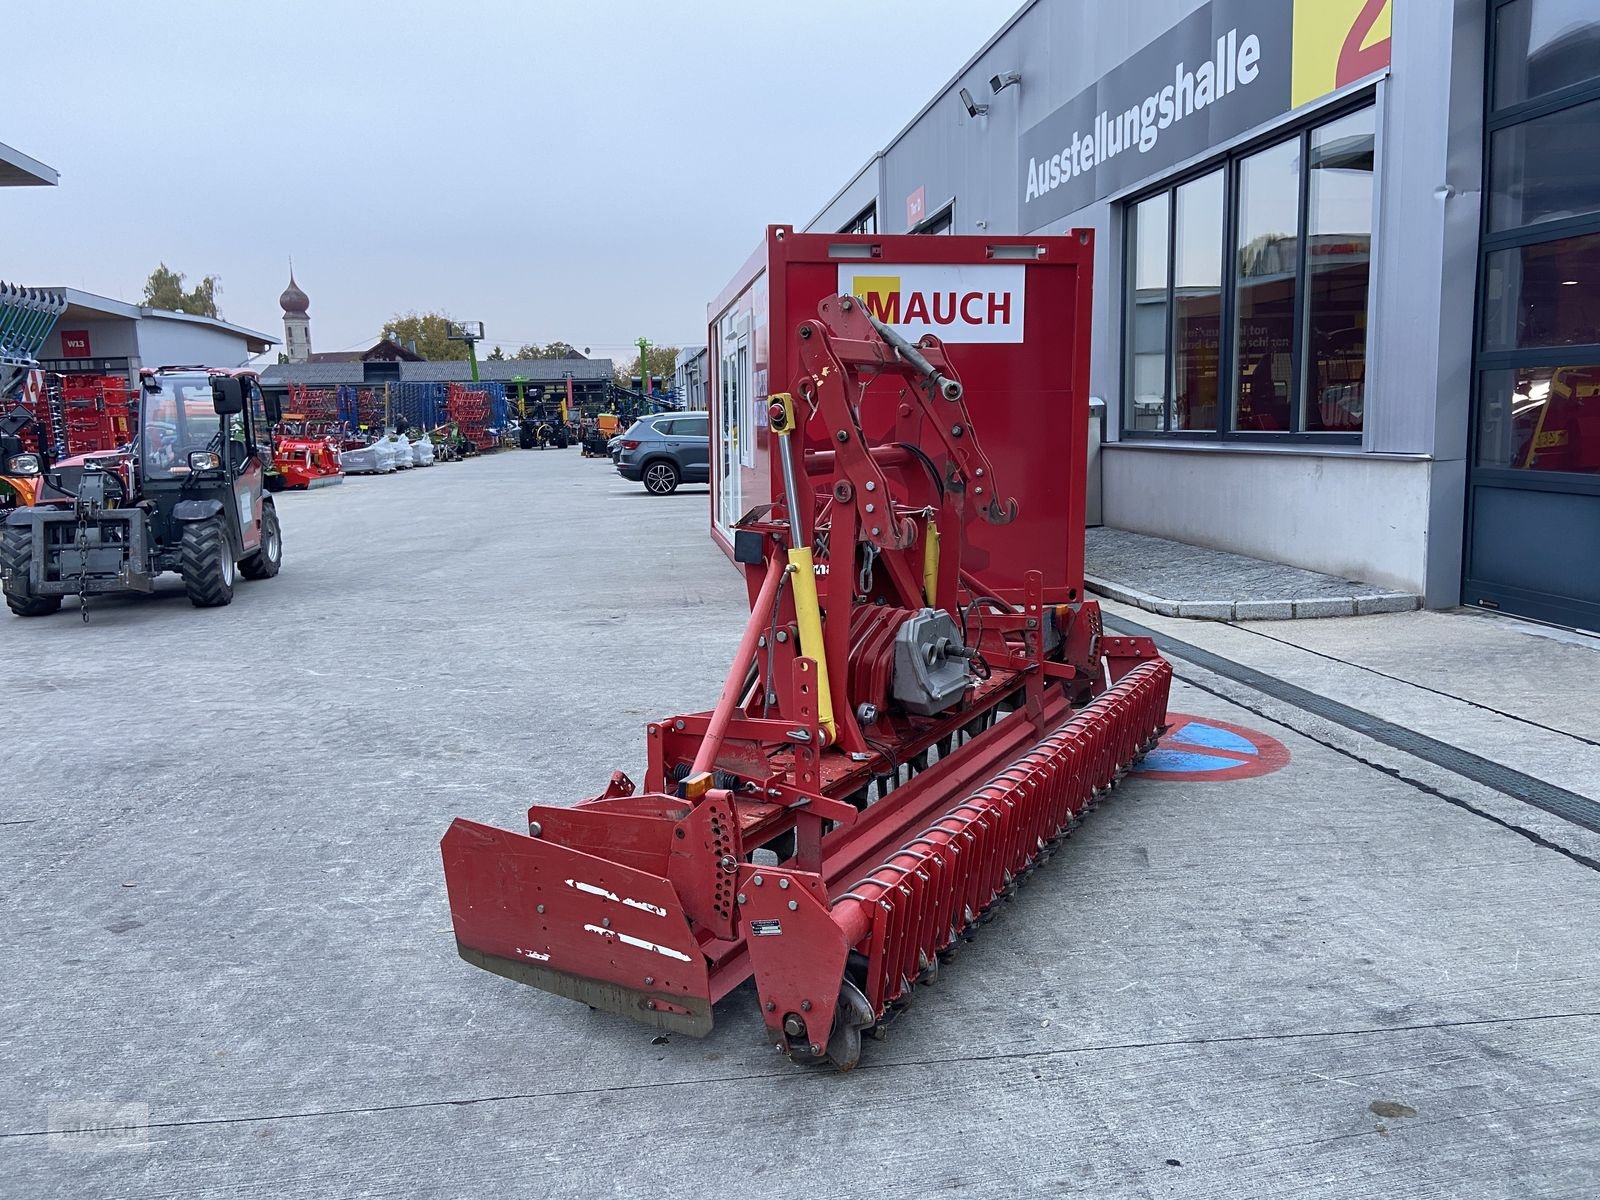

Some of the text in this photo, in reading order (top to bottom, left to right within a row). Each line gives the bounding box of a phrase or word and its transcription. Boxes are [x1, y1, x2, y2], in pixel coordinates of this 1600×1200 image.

[1025, 28, 1261, 203] Ausstellungshalle
[866, 291, 1011, 325] MAUCH
[67, 340, 85, 348] W13
